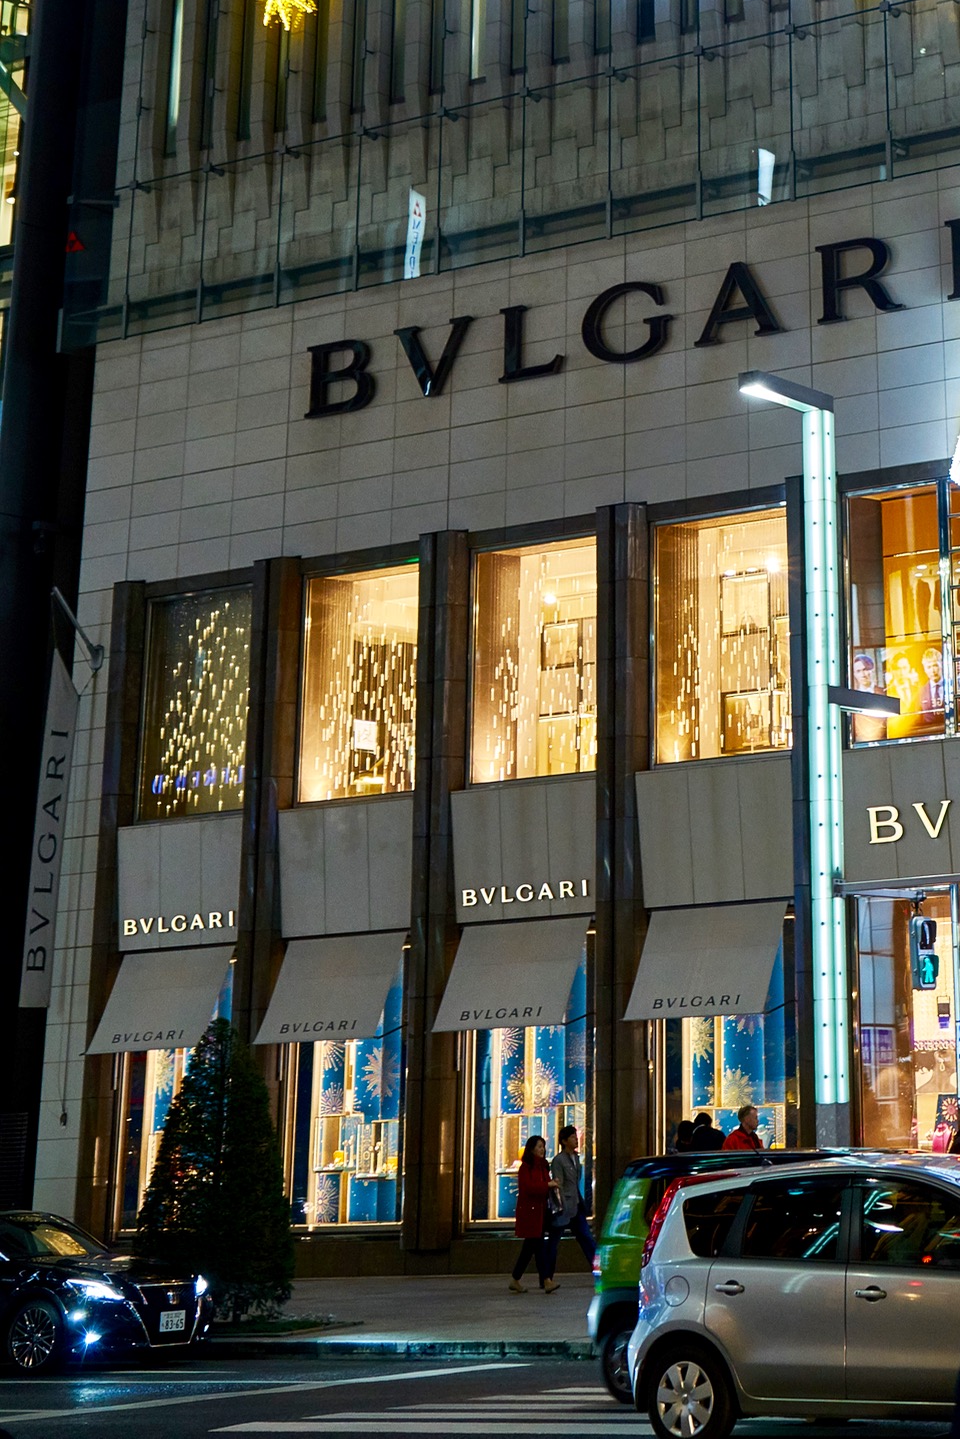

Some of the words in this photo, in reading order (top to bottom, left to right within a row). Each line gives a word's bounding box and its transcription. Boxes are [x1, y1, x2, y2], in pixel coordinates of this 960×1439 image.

[26, 729, 69, 973] BVLGARI
[462, 879, 589, 907] BVLGARI
[123, 910, 235, 936] BVLGARI
[653, 993, 742, 1010] BVLGARI
[459, 1005, 543, 1022] BVLGARI
[280, 1019, 357, 1034] BVLGARI
[111, 1029, 185, 1044] BVLGARI
